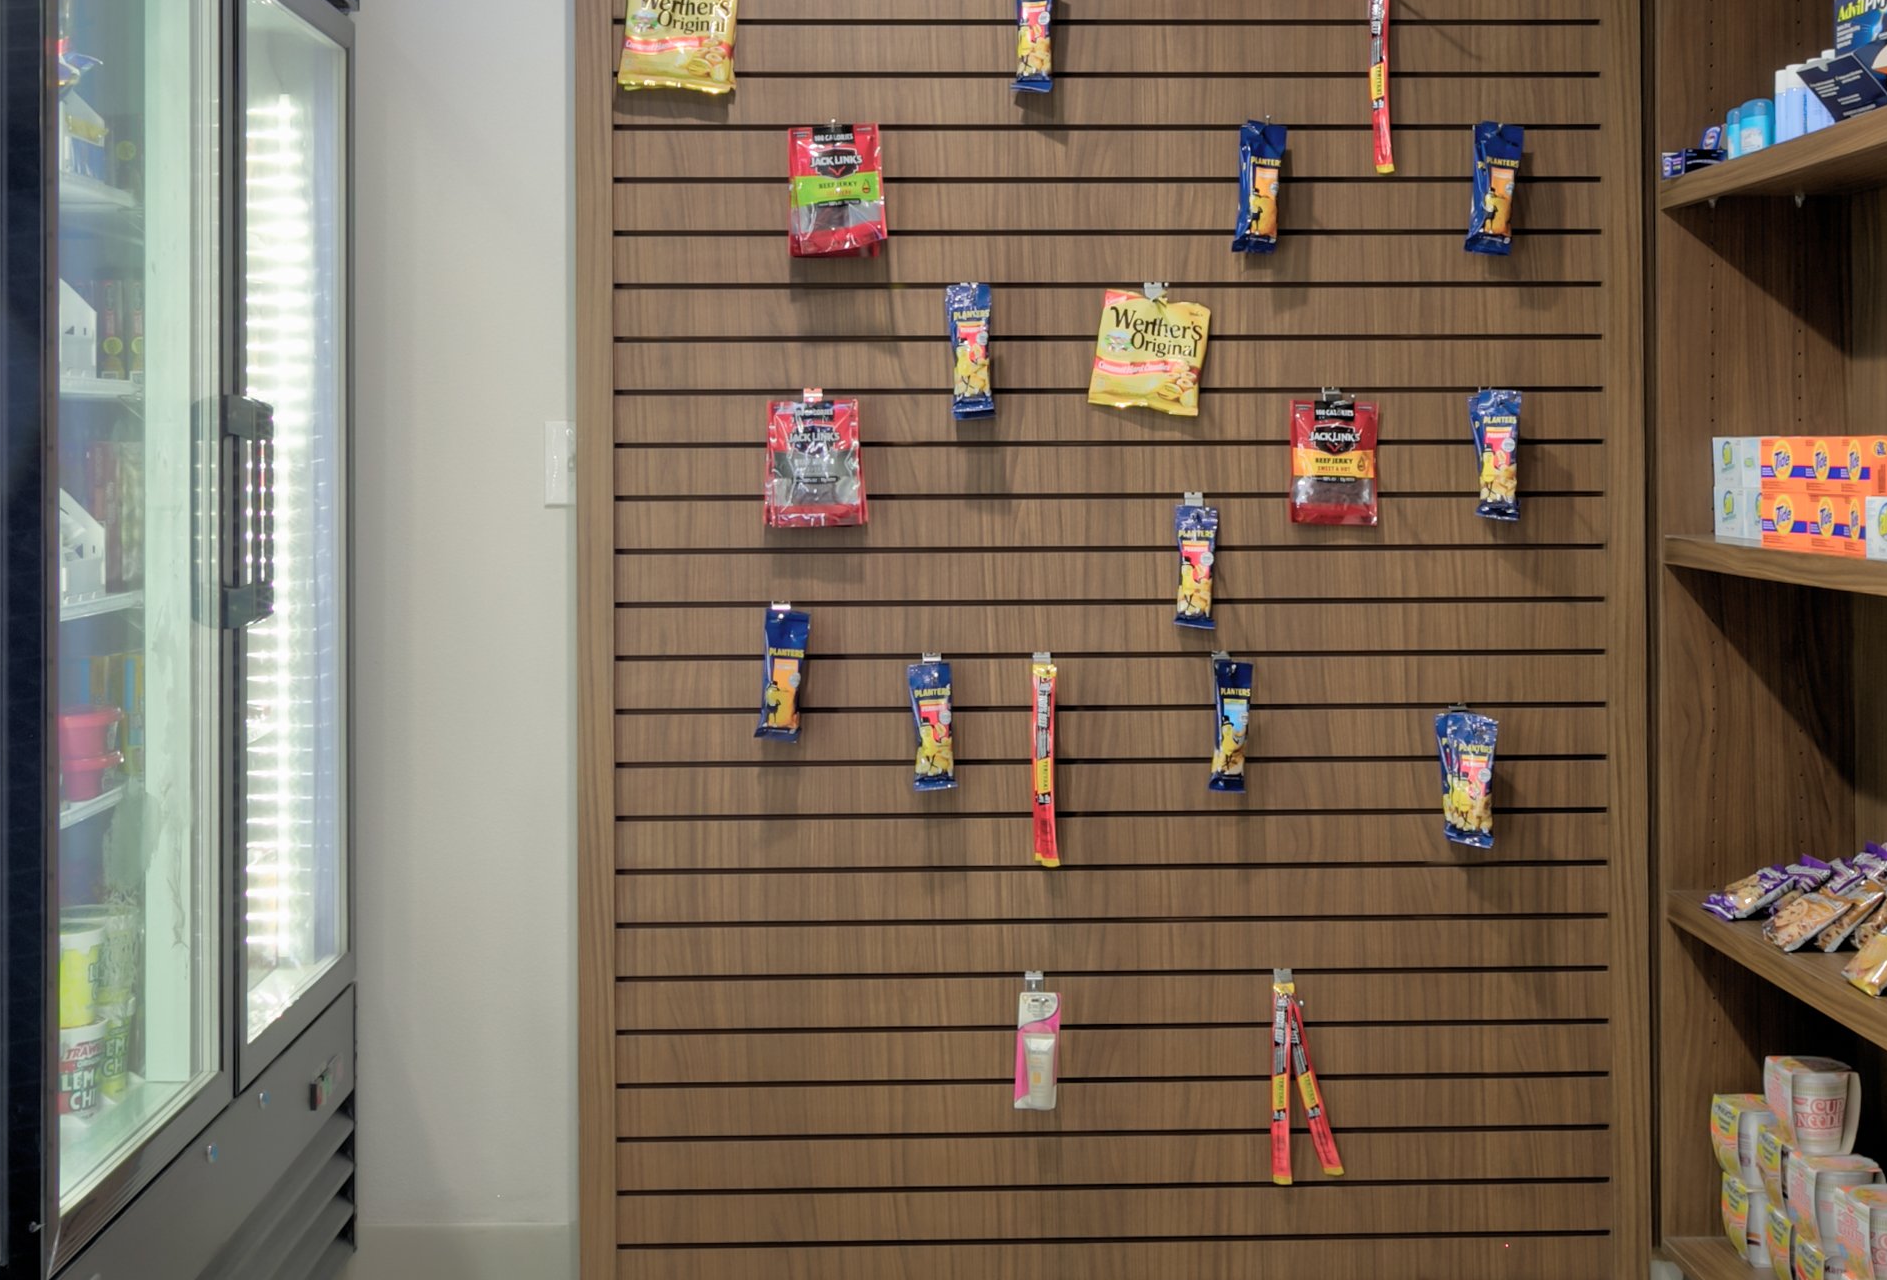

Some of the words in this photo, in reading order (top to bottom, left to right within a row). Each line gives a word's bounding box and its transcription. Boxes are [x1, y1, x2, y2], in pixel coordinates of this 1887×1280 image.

[810, 156, 834, 168] JACK
[1486, 156, 1519, 168] PLANTERS
[1111, 306, 1203, 340] Werther's
[1131, 331, 1196, 357] Original
[1483, 416, 1516, 425] PLANTERS
[1310, 431, 1333, 442] JACK
[1774, 450, 1790, 468] Tide
[1815, 451, 1828, 468] Tide
[1775, 504, 1791, 521] Tide
[1819, 507, 1832, 524] Tide
[769, 647, 804, 658] PLANTERS
[1220, 687, 1251, 697] PLANTERS
[1810, 1098, 1845, 1114] CUP
